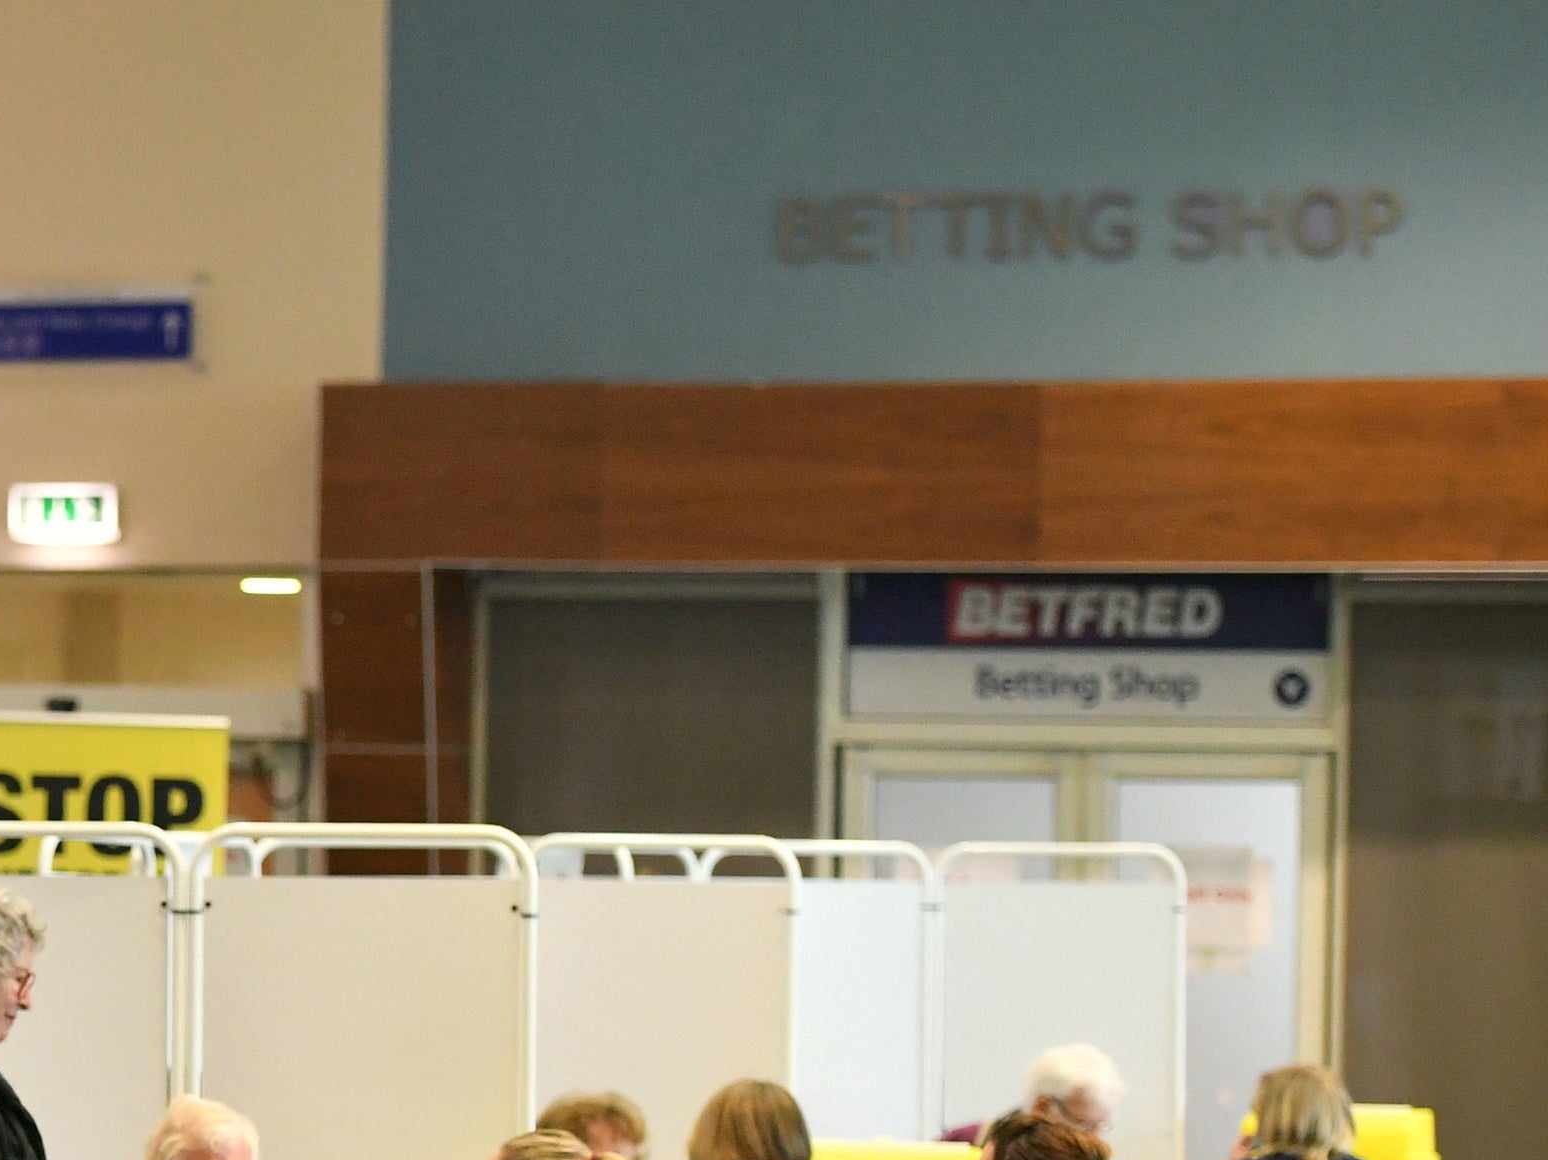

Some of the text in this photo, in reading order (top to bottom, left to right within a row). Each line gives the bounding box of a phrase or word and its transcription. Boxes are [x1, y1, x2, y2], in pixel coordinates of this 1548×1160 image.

[775, 189, 1404, 264] BETTING SHOP
[954, 584, 1222, 639] BETFRED
[975, 665, 1200, 707] Betting Shop
